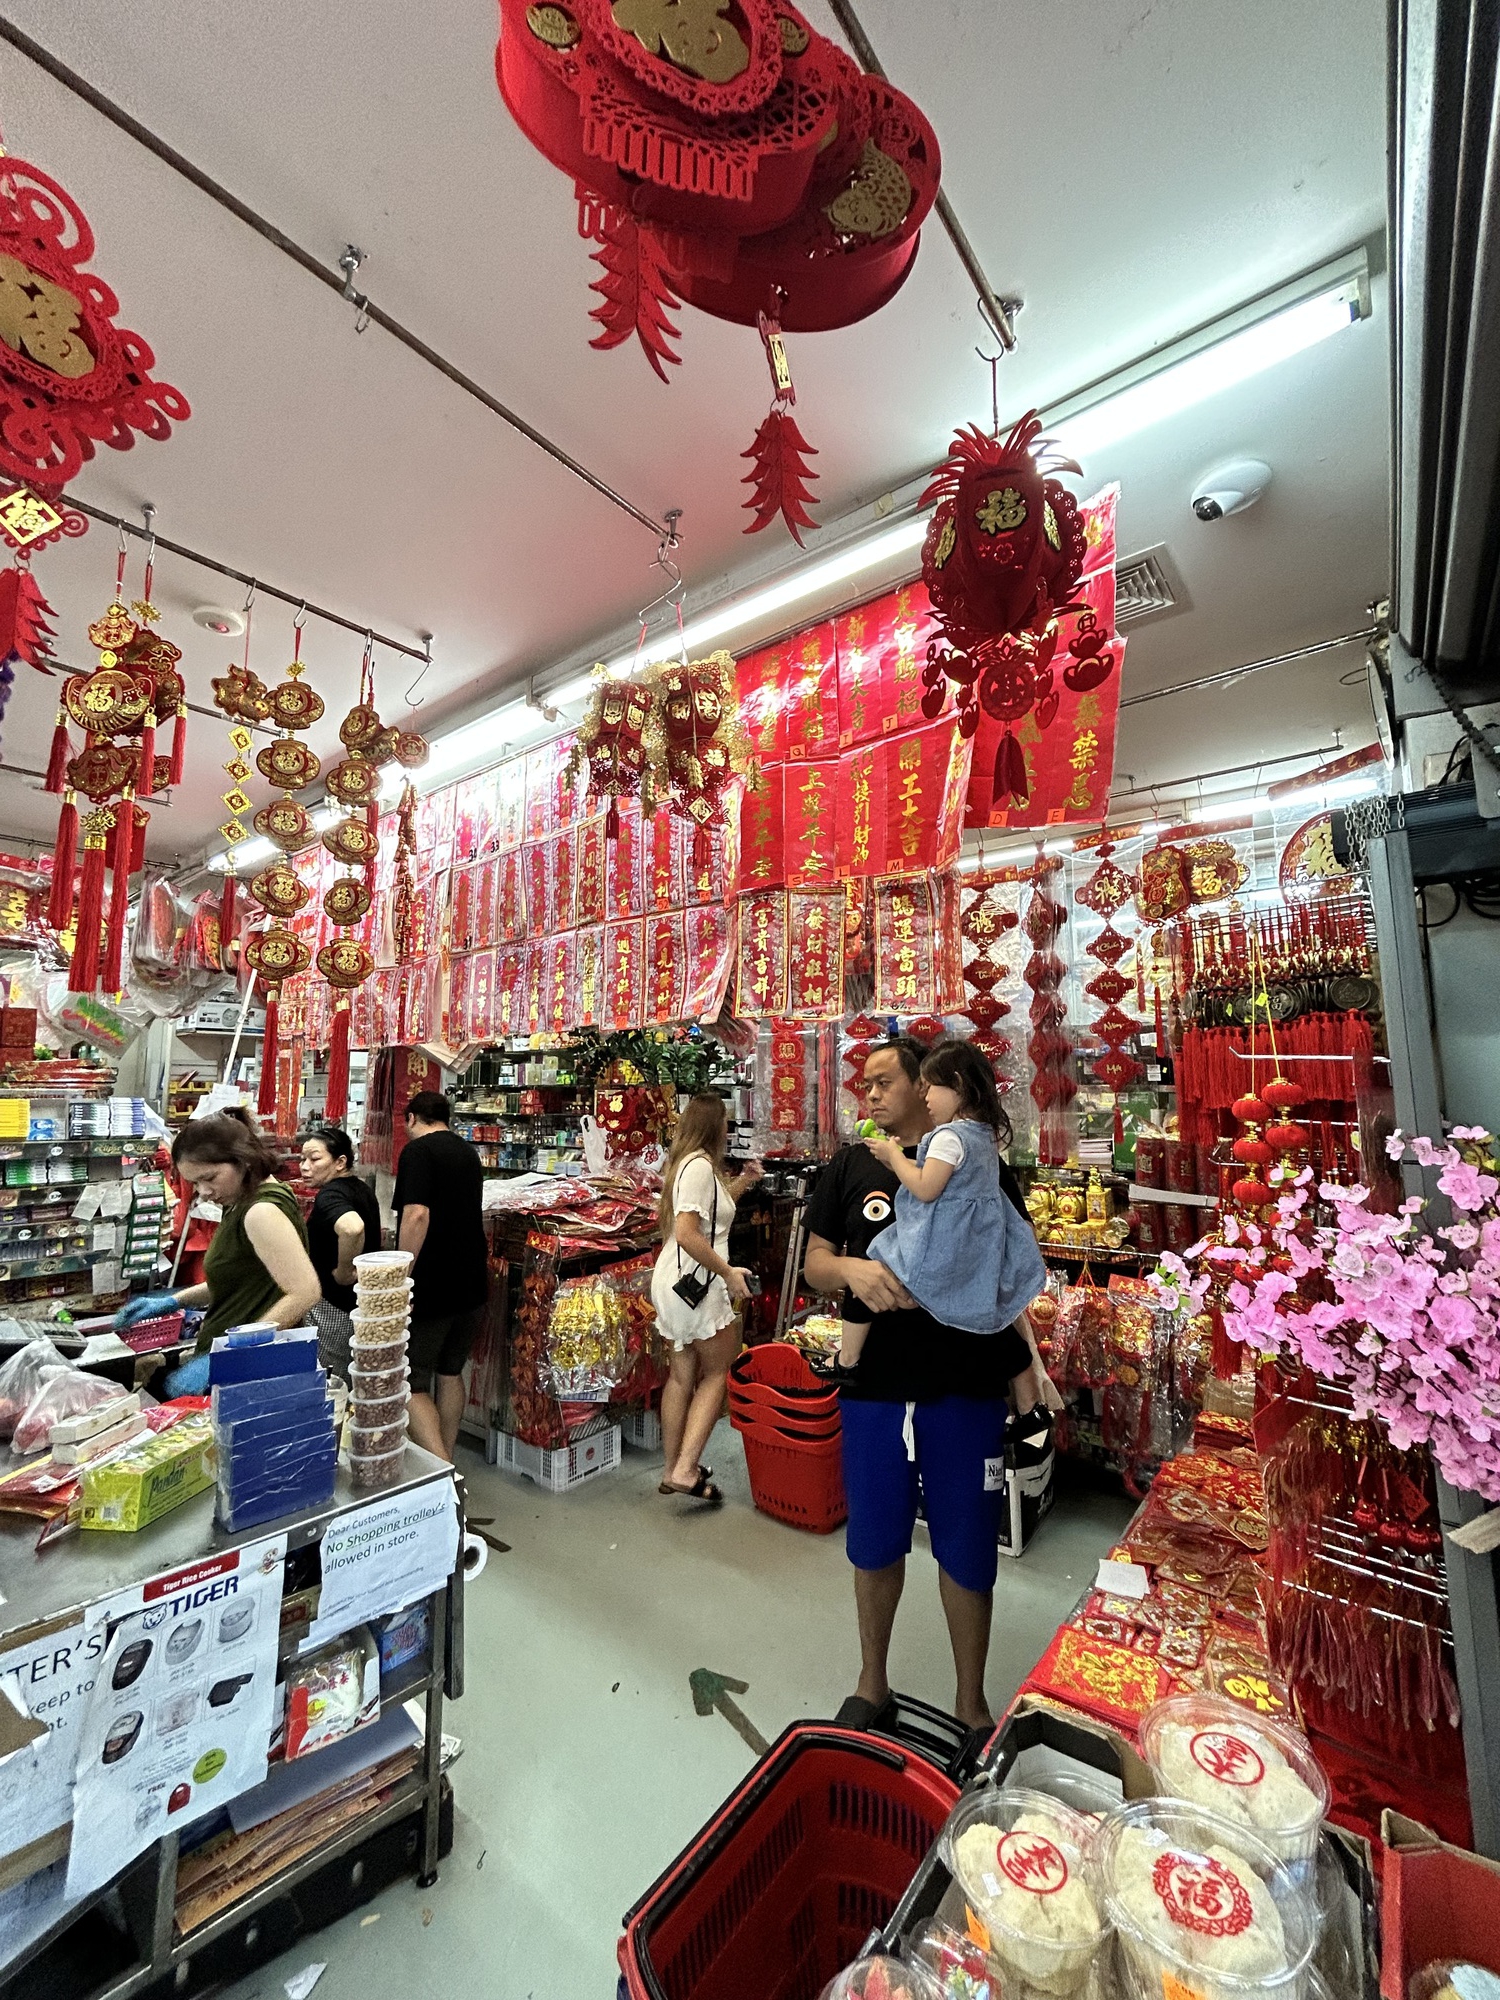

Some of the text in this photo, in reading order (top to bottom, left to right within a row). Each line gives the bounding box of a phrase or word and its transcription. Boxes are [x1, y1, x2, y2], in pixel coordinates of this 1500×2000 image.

[975, 488, 1026, 534] 福
[886, 718, 894, 729] J
[793, 747, 804, 757] Q
[898, 738, 925, 857] 開工大吉
[992, 813, 1003, 825] D
[1051, 810, 1060, 822] E
[491, 840, 499, 853] 33
[792, 876, 801, 886] S
[839, 868, 848, 877] L
[890, 861, 900, 872] M
[1191, 865, 1221, 896] 福
[752, 907, 772, 1001] 富貴吉祥
[151, 1460, 185, 1494] Pandan
[326, 1502, 446, 1557] No Shopping trolley's
[328, 1506, 400, 1540] Dear Customers,
[324, 1531, 420, 1575] allowed in store.
[162, 1564, 223, 1592] Tiger Rice Cooker
[169, 1575, 240, 1617] TIGER
[0, 1634, 101, 1683] TER'S
[77, 1680, 95, 1696] to
[1176, 1868, 1224, 1916] 福
